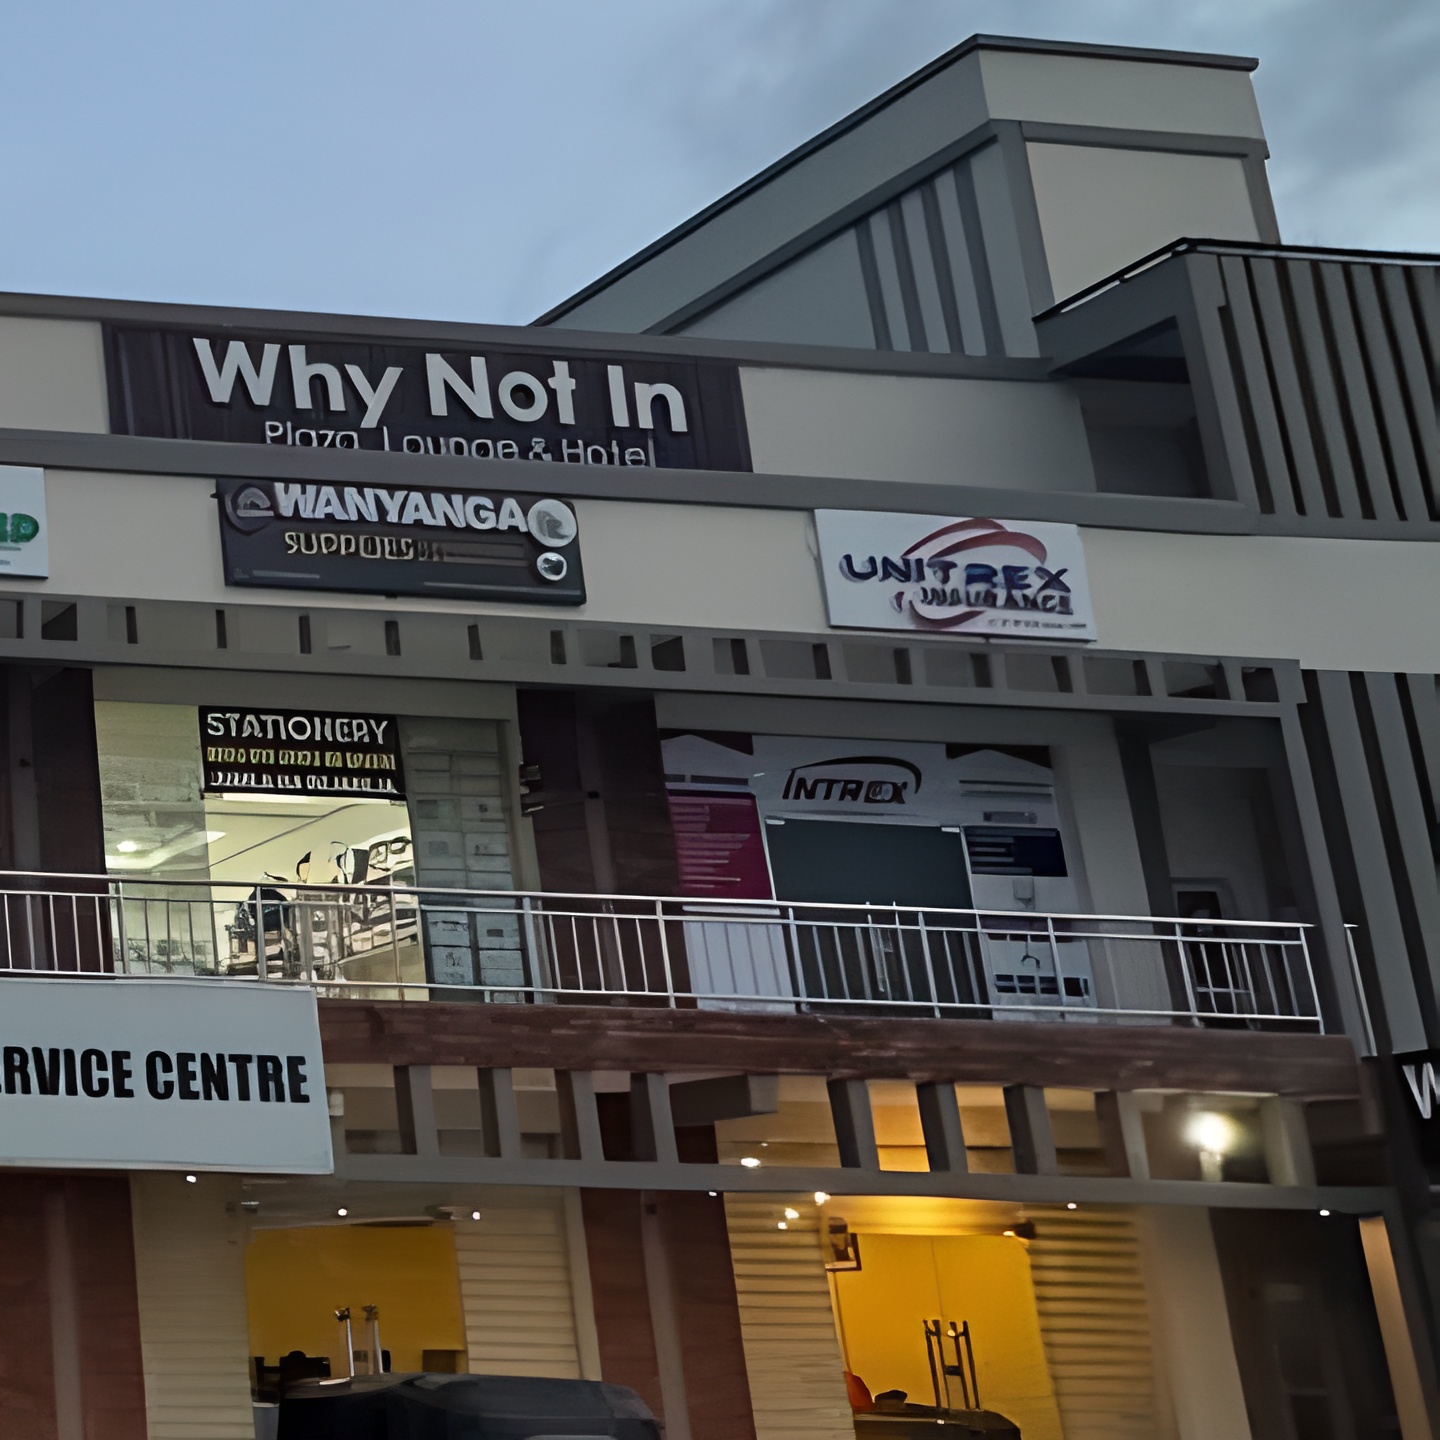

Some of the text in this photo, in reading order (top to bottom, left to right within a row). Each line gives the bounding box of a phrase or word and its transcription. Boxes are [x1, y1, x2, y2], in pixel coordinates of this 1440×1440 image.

[192, 337, 689, 433] Why Not In
[272, 481, 530, 533] WANYANGA
[145, 1049, 311, 1104] CENTRE
